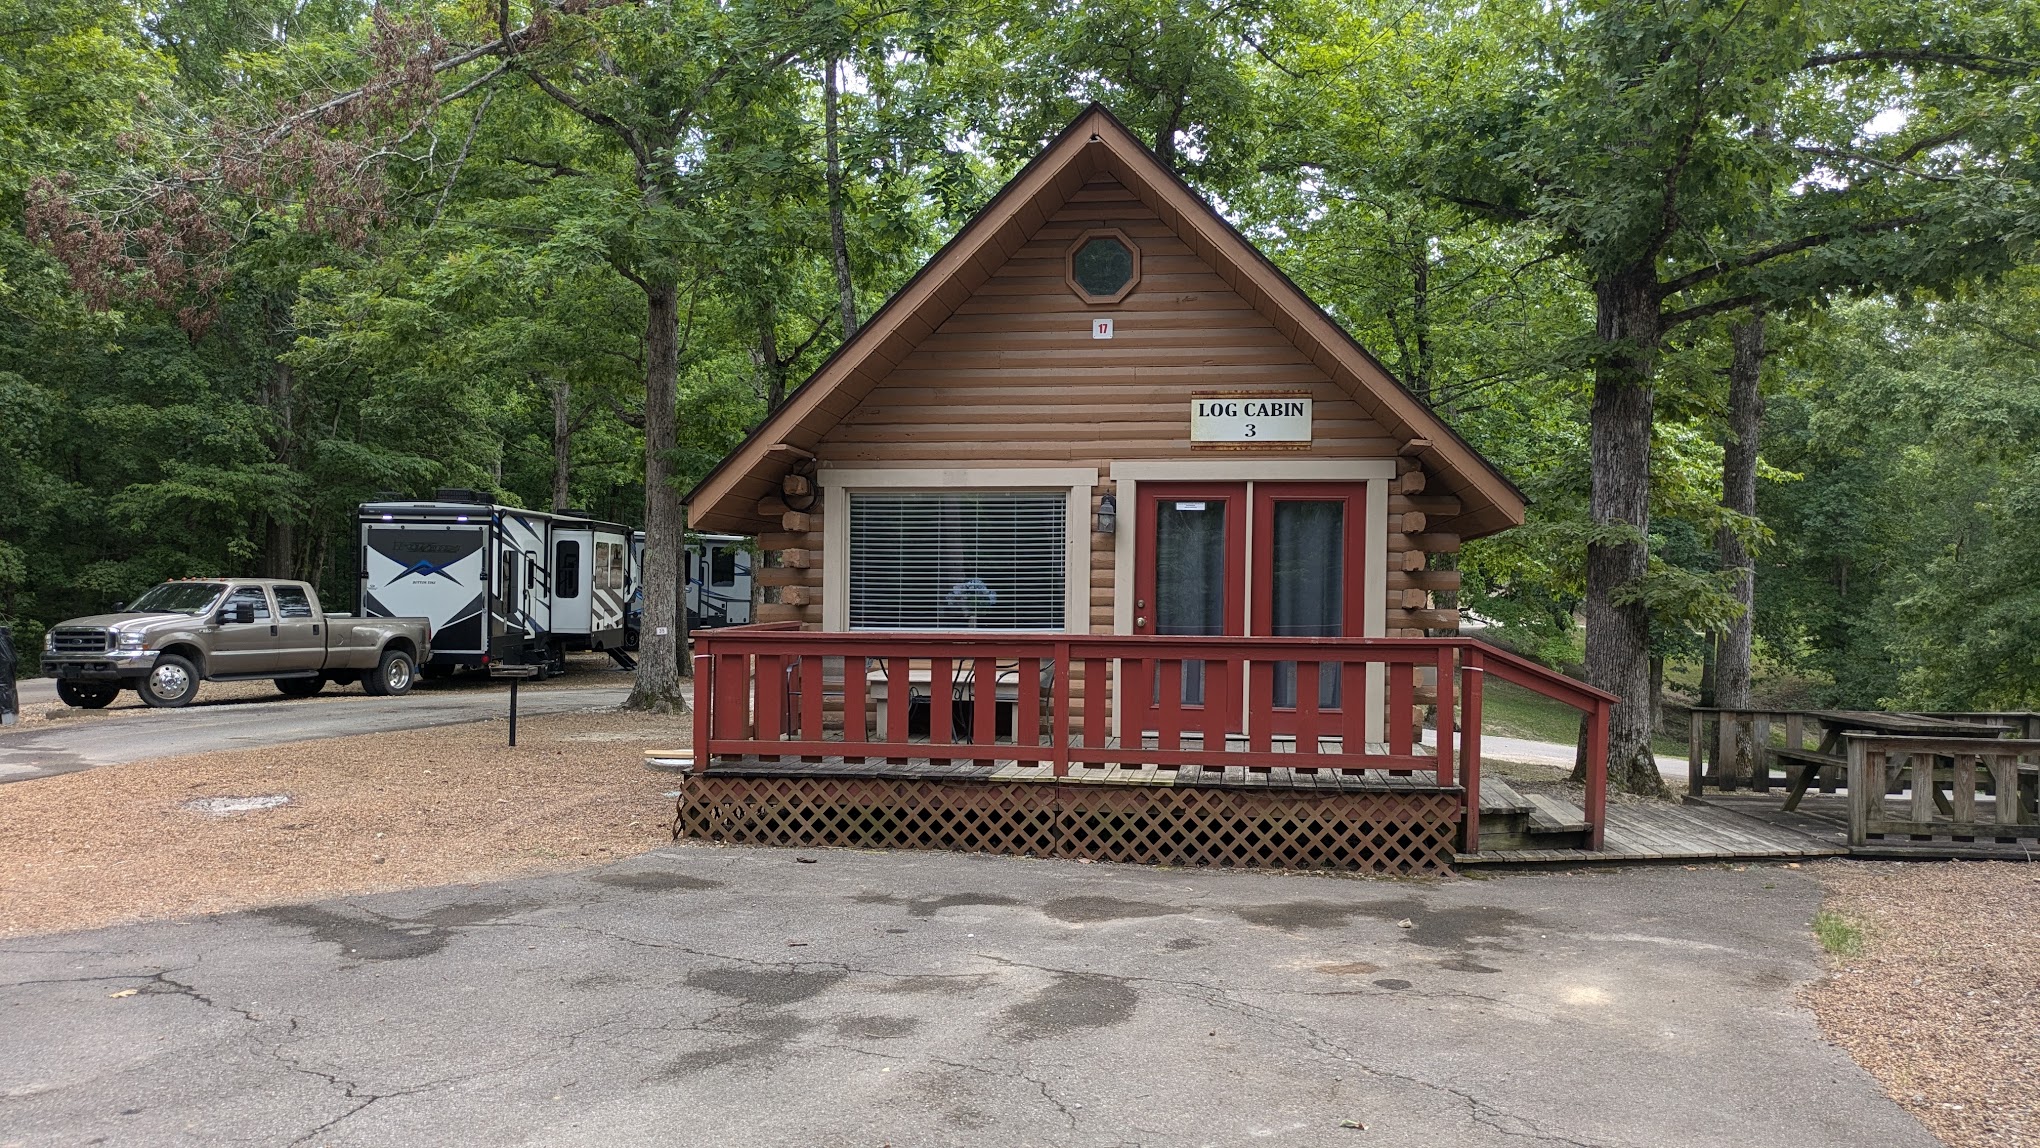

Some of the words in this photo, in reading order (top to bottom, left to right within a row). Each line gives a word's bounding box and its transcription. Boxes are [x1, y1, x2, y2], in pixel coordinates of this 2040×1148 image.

[1098, 324, 1107, 333] 17
[1199, 403, 1237, 417] LOG
[1244, 402, 1304, 417] CABIN
[1245, 423, 1256, 437] 3
